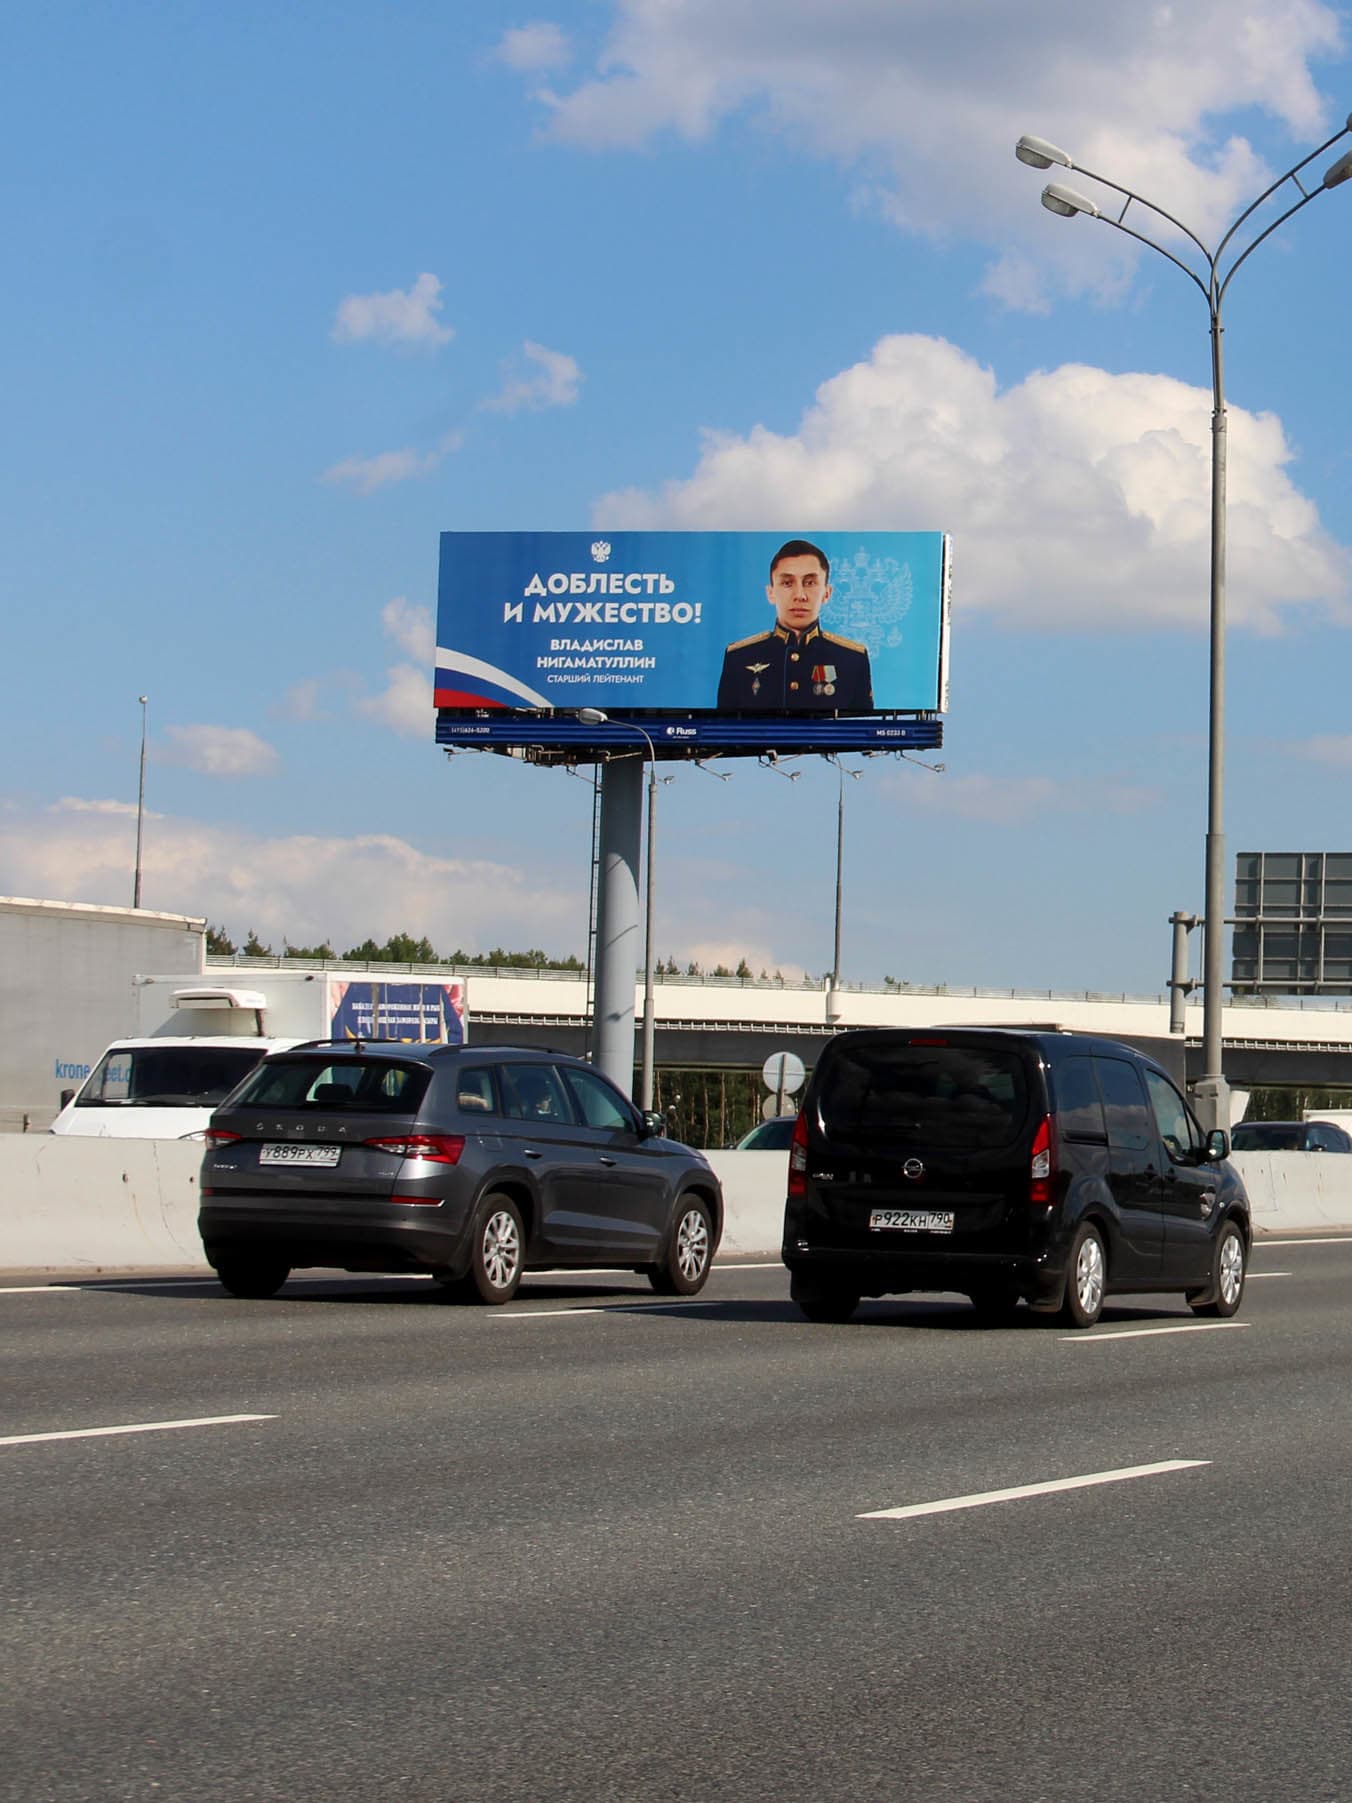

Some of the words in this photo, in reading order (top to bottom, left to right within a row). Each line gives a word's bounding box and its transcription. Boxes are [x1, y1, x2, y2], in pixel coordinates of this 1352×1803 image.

[524, 573, 675, 596] ДОБЛЕСТЬ
[503, 602, 523, 624] И
[533, 602, 702, 624] МУЖЕСТВО!
[550, 639, 644, 652] ВЛАДИСЛАВ
[536, 656, 656, 669] НИГАМАТУЛЛИН
[547, 672, 591, 683] СТАРШИЙ
[593, 672, 645, 684] ЛЕЙТЕНАНТ
[676, 726, 697, 735] Russ
